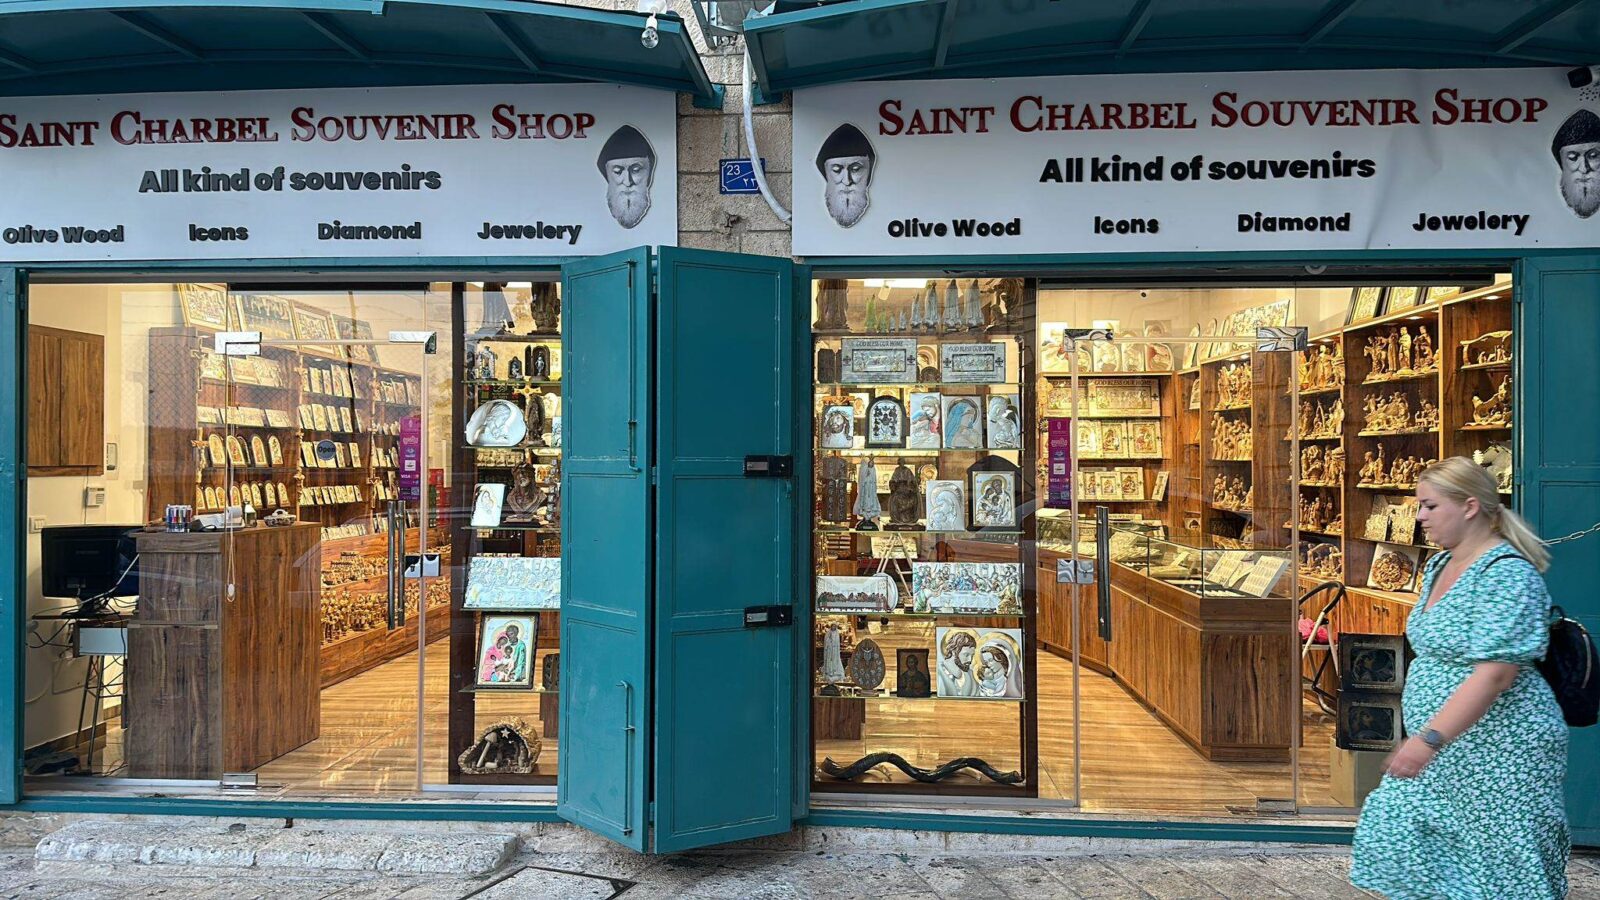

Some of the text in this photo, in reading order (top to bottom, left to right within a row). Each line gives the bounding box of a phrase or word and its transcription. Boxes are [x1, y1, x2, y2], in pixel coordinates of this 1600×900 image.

[878, 87, 1548, 135] SAINT CHARBEL SOUVENIR SHOP
[111, 110, 279, 145] CHARBEL
[290, 107, 480, 142] SOUVENIR
[491, 103, 596, 139] SHOP
[726, 164, 740, 176] 23
[1040, 150, 1377, 183] All kind of souvenirs
[139, 164, 441, 192] All kind of souvenirs
[188, 223, 249, 241] Icons
[317, 221, 422, 241] Diamond
[887, 217, 1021, 238] Olive Wood
[1094, 215, 1160, 234] Icons
[1237, 211, 1351, 233] Diamond
[1412, 211, 1531, 237] Jewelery
[3, 224, 124, 244] Olive Wood
[477, 221, 582, 245] Jewelery
[318, 446, 336, 454] Open
